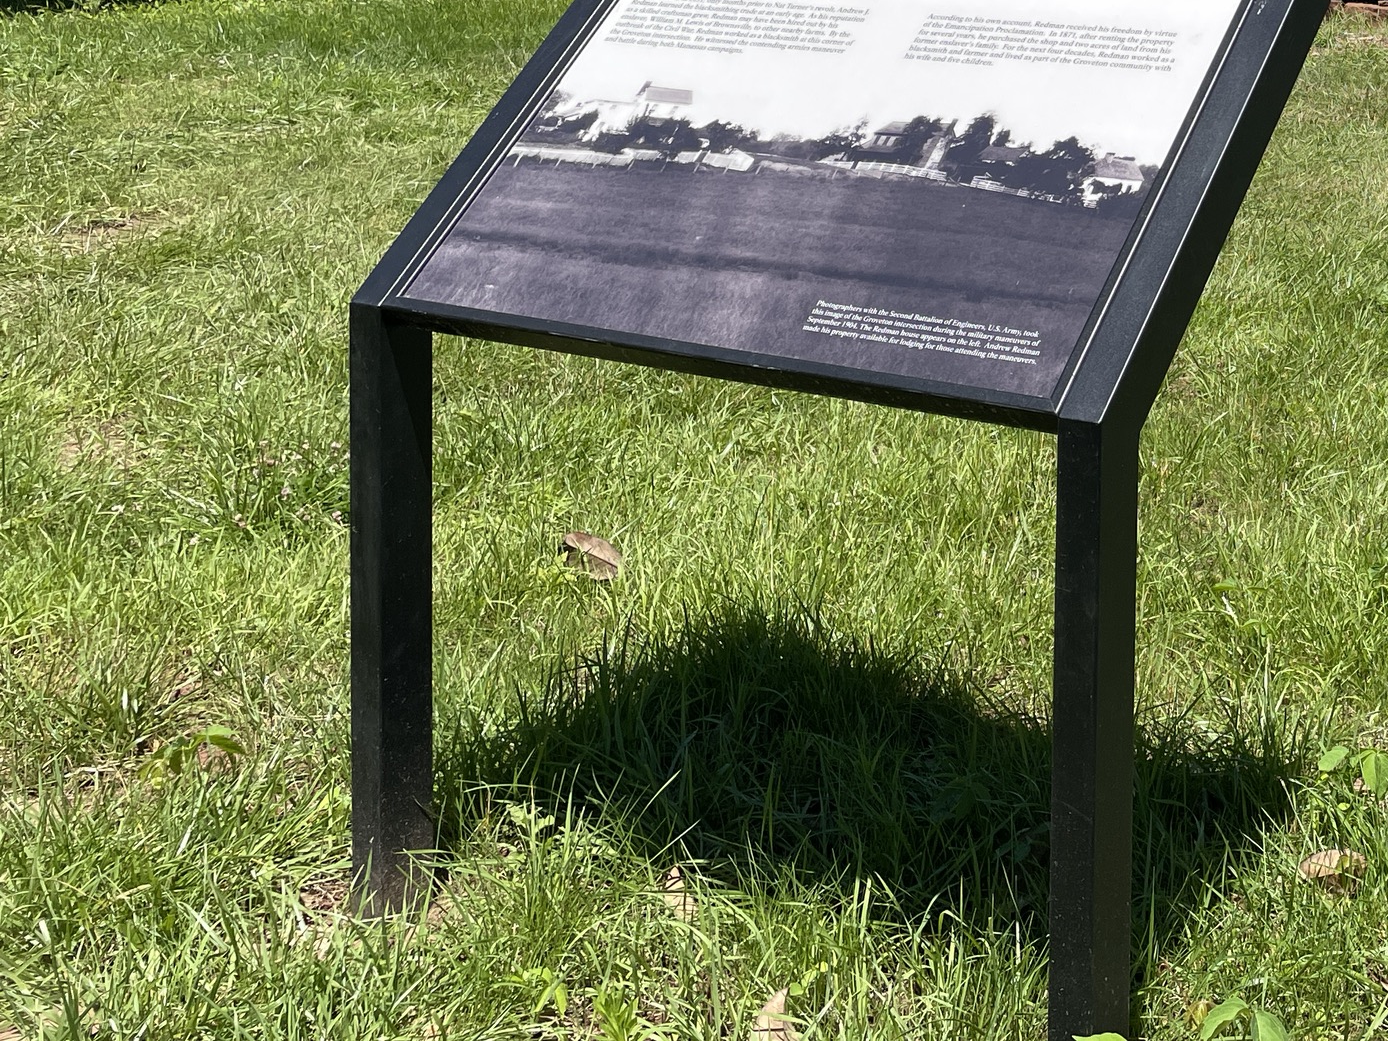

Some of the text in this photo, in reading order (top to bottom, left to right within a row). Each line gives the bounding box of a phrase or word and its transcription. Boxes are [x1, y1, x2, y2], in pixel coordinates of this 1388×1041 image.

[927, 14, 964, 23] According
[944, 23, 994, 32] Emancipation
[995, 26, 1043, 35] Proclamation.
[1098, 35, 1126, 43] renting
[1040, 38, 1058, 46] shop
[908, 45, 947, 53] blacksmith
[1004, 52, 1024, 60] lived
[1073, 58, 1108, 66] Groveton
[1109, 62, 1153, 71] community
[961, 58, 993, 66] children.
[1064, 49, 1095, 57] decades,
[1098, 51, 1129, 59] Redman
[816, 300, 862, 311] Photographers
[889, 310, 914, 318] Second
[913, 314, 943, 322] Battalion
[952, 319, 985, 329] Engineers,
[1002, 327, 1021, 335] Army,
[824, 310, 843, 318] image
[863, 316, 893, 324] Groveton
[894, 321, 932, 330] intersection
[932, 326, 955, 334] during
[967, 331, 994, 340] military
[994, 336, 1030, 344] maneuvers
[807, 316, 841, 325] September
[872, 325, 899, 334] Redman
[900, 329, 920, 337] house
[984, 342, 1011, 350] Andrew
[1011, 346, 1040, 354] Redman
[830, 329, 859, 338] property
[899, 338, 924, 348] lodging
[954, 348, 986, 357] attending
[998, 355, 1036, 363] maneuvers.
